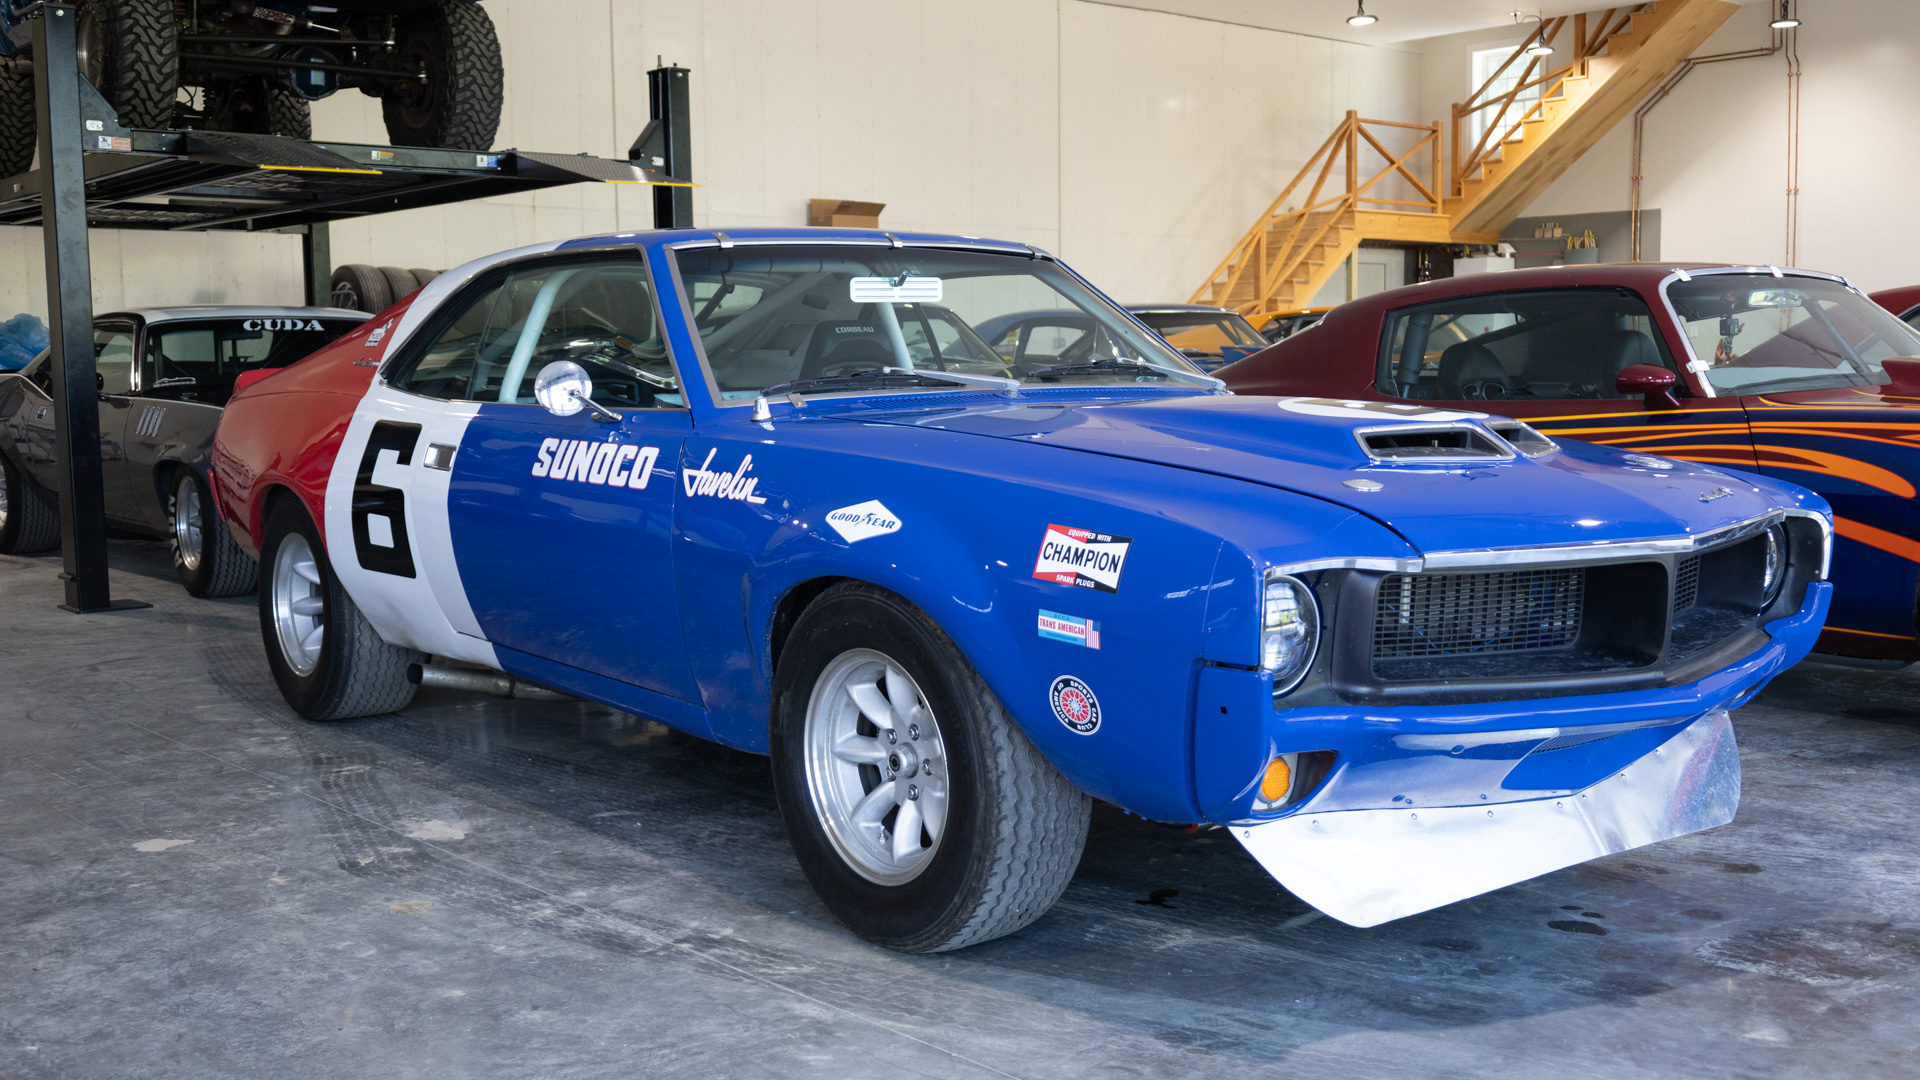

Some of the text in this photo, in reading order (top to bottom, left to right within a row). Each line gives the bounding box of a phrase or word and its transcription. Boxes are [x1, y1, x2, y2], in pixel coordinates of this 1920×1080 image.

[243, 319, 325, 331] CUDA
[835, 326, 875, 334] CORBEAU
[531, 437, 660, 490] SUNOCO
[682, 447, 768, 505] Javelin
[352, 419, 423, 579] 6
[1068, 528, 1112, 543] EQUIPPED WITH
[1043, 541, 1122, 573] CHAMPION
[1055, 574, 1095, 588] SPARK PLUGS
[1039, 617, 1085, 636] TRANS AMERICAN
[1057, 682, 1064, 691] OF
[1070, 680, 1094, 704] SPORTS
[1053, 690, 1069, 723] AMERICA
